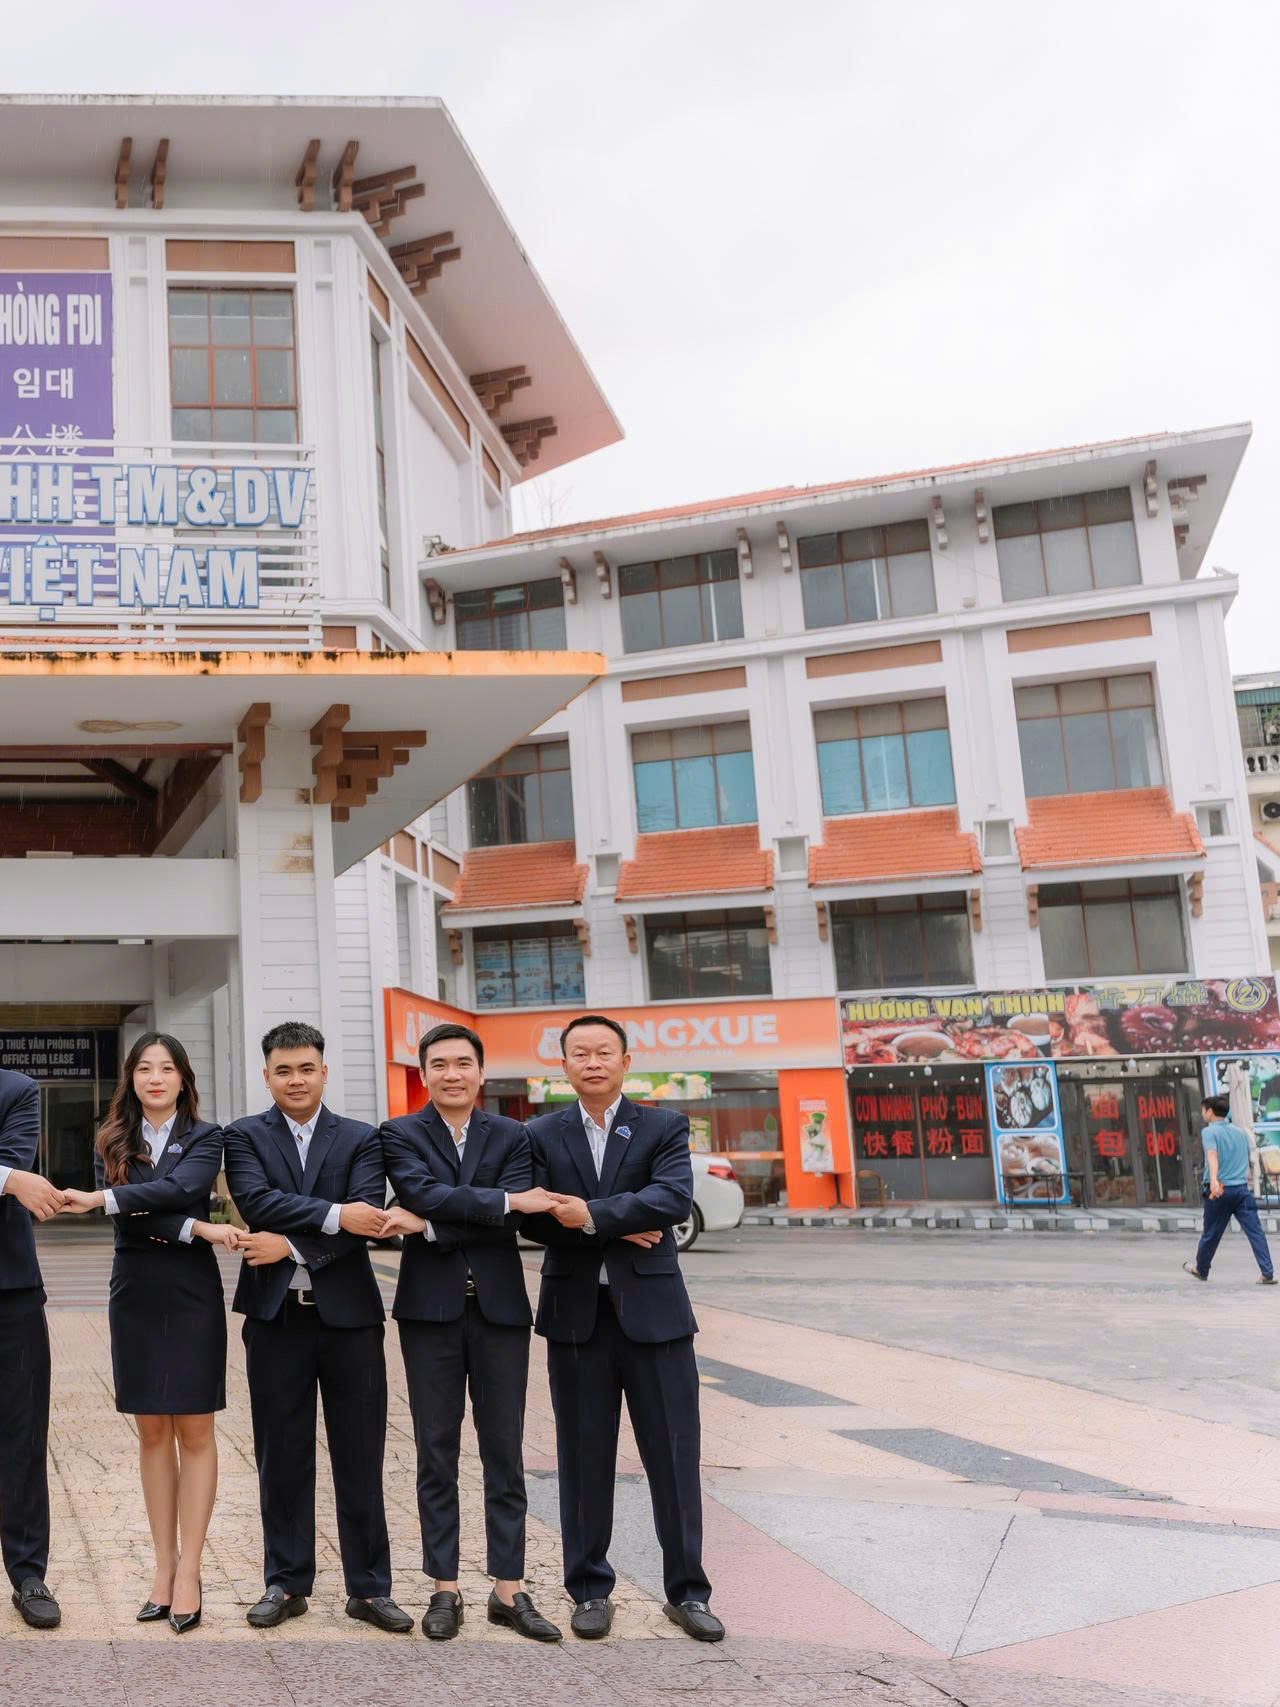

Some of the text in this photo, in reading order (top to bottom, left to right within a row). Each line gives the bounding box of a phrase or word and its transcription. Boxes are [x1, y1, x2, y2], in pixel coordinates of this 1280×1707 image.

[67, 294, 102, 346] FDI
[13, 367, 74, 399] 임대
[118, 547, 260, 608] NAM
[76, 1039, 90, 1050] FDI
[622, 1014, 779, 1048] NGXUE
[2, 1053, 30, 1065] OFFICE
[31, 1053, 47, 1065] FOR
[49, 1053, 74, 1065] LEASE
